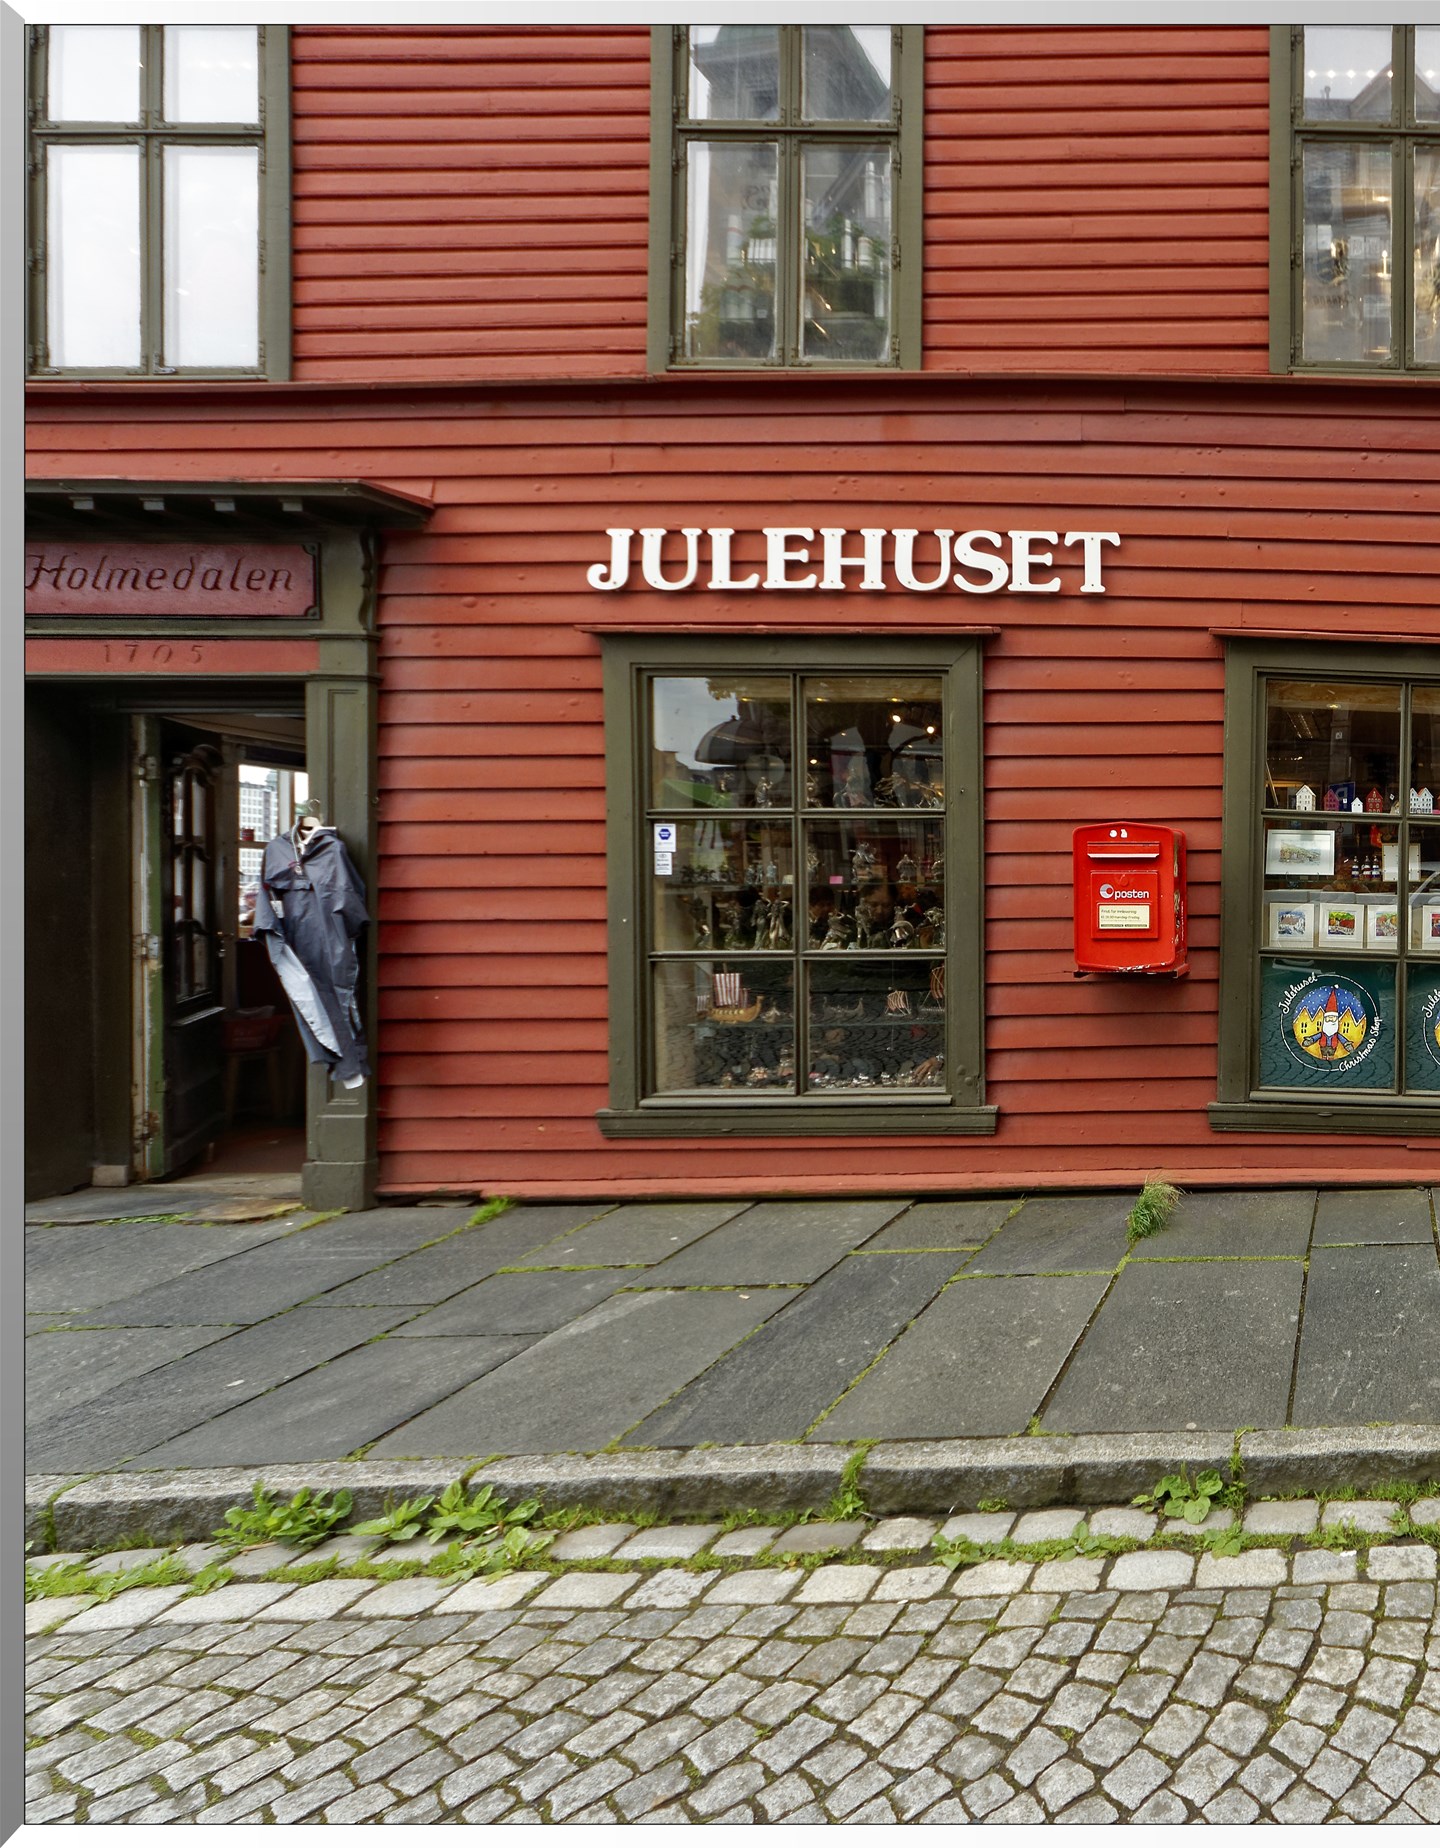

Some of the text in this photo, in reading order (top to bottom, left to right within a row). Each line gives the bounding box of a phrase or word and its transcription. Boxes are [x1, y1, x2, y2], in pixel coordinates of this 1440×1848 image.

[25, 554, 294, 592] Holmedalen
[586, 527, 1121, 594] JULEHUSET
[103, 644, 205, 665] 1705
[1114, 889, 1150, 900] posten
[1278, 971, 1318, 1014] Julehuset
[1338, 1016, 1383, 1072] Christmas Shop
